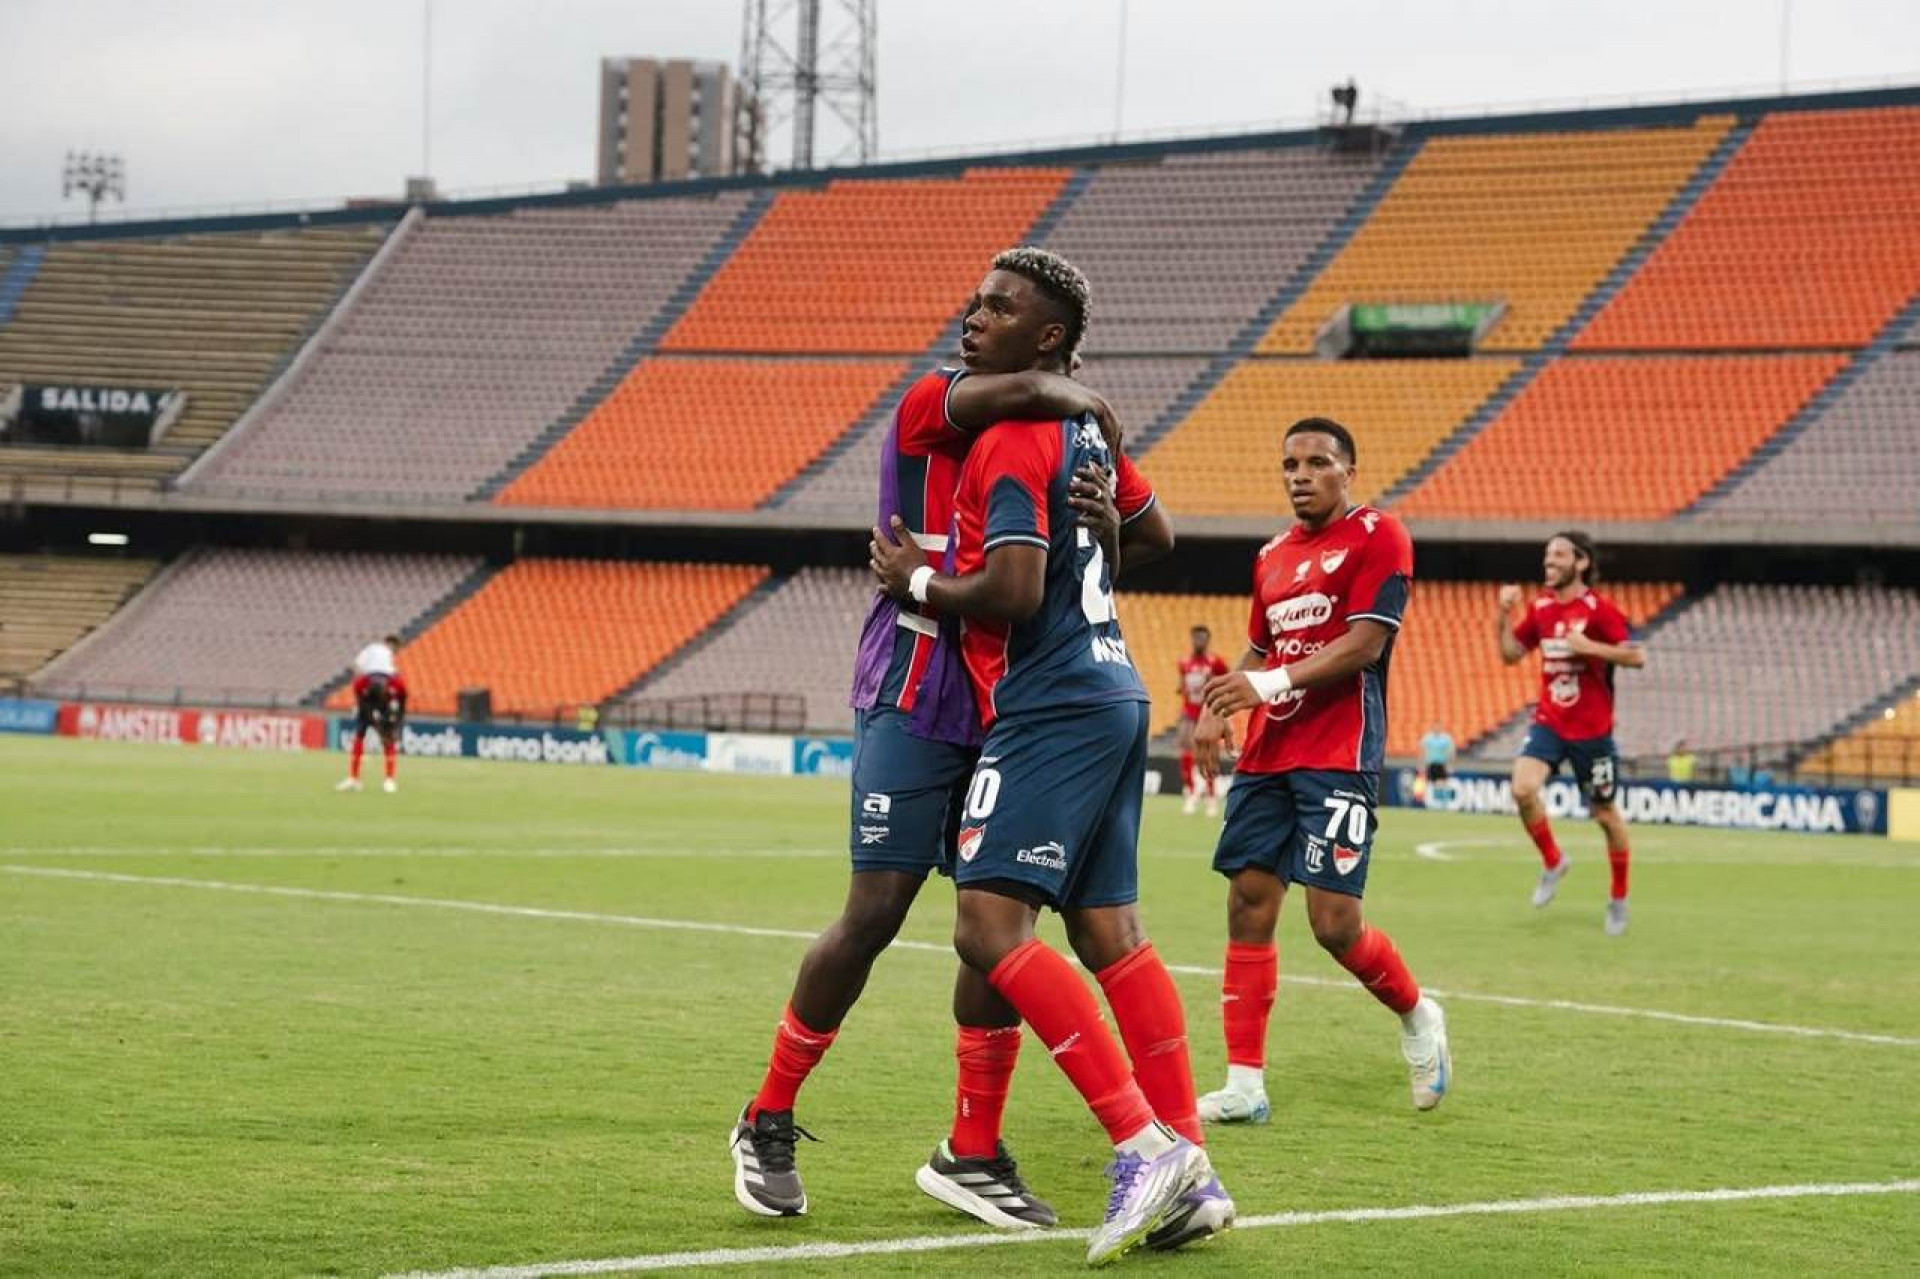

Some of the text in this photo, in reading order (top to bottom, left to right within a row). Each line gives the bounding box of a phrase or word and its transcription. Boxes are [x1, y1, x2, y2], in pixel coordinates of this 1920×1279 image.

[41, 388, 150, 412] SALIDA
[102, 707, 179, 742] AMSTEL
[218, 715, 301, 748] AMSTEL
[542, 732, 608, 764] bank
[1323, 797, 1368, 845] 70
[1615, 785, 1845, 831] UDAMERICANA
